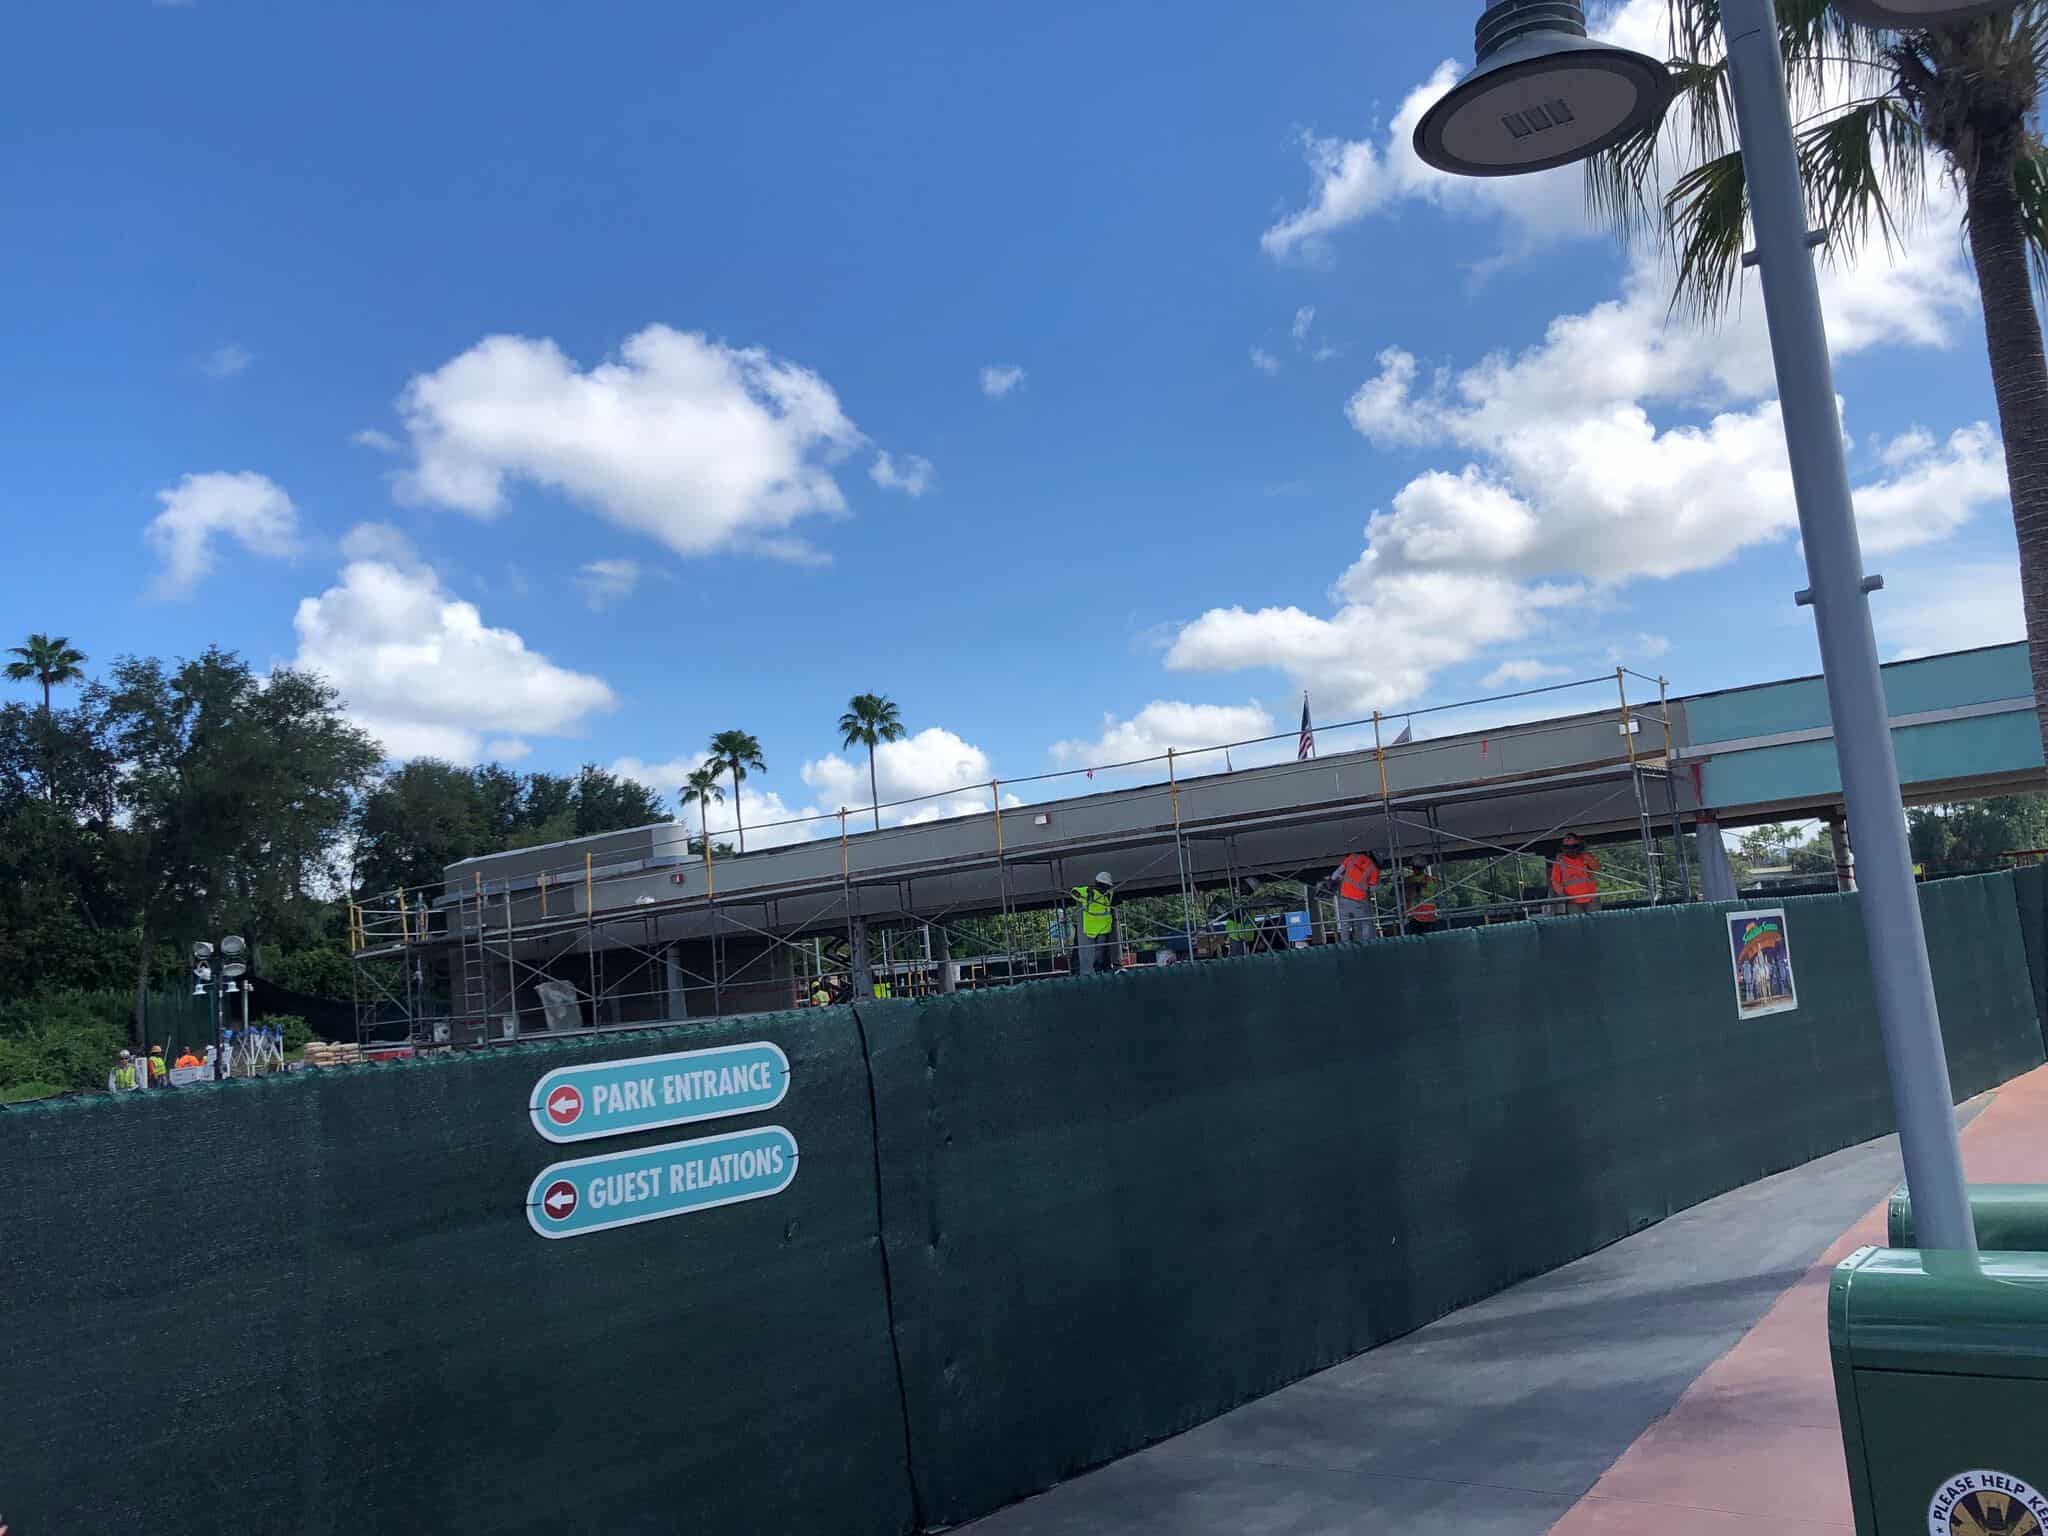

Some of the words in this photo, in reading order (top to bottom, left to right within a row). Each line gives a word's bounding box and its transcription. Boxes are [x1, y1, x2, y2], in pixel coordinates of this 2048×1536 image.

[592, 1078, 656, 1116] PARK
[663, 1061, 772, 1105] ENTRANCE
[588, 1167, 663, 1209] GUEST
[669, 1144, 784, 1194] RELATIONS
[1933, 1475, 1975, 1521] PLEASE
[1981, 1474, 2025, 1495] HELP
